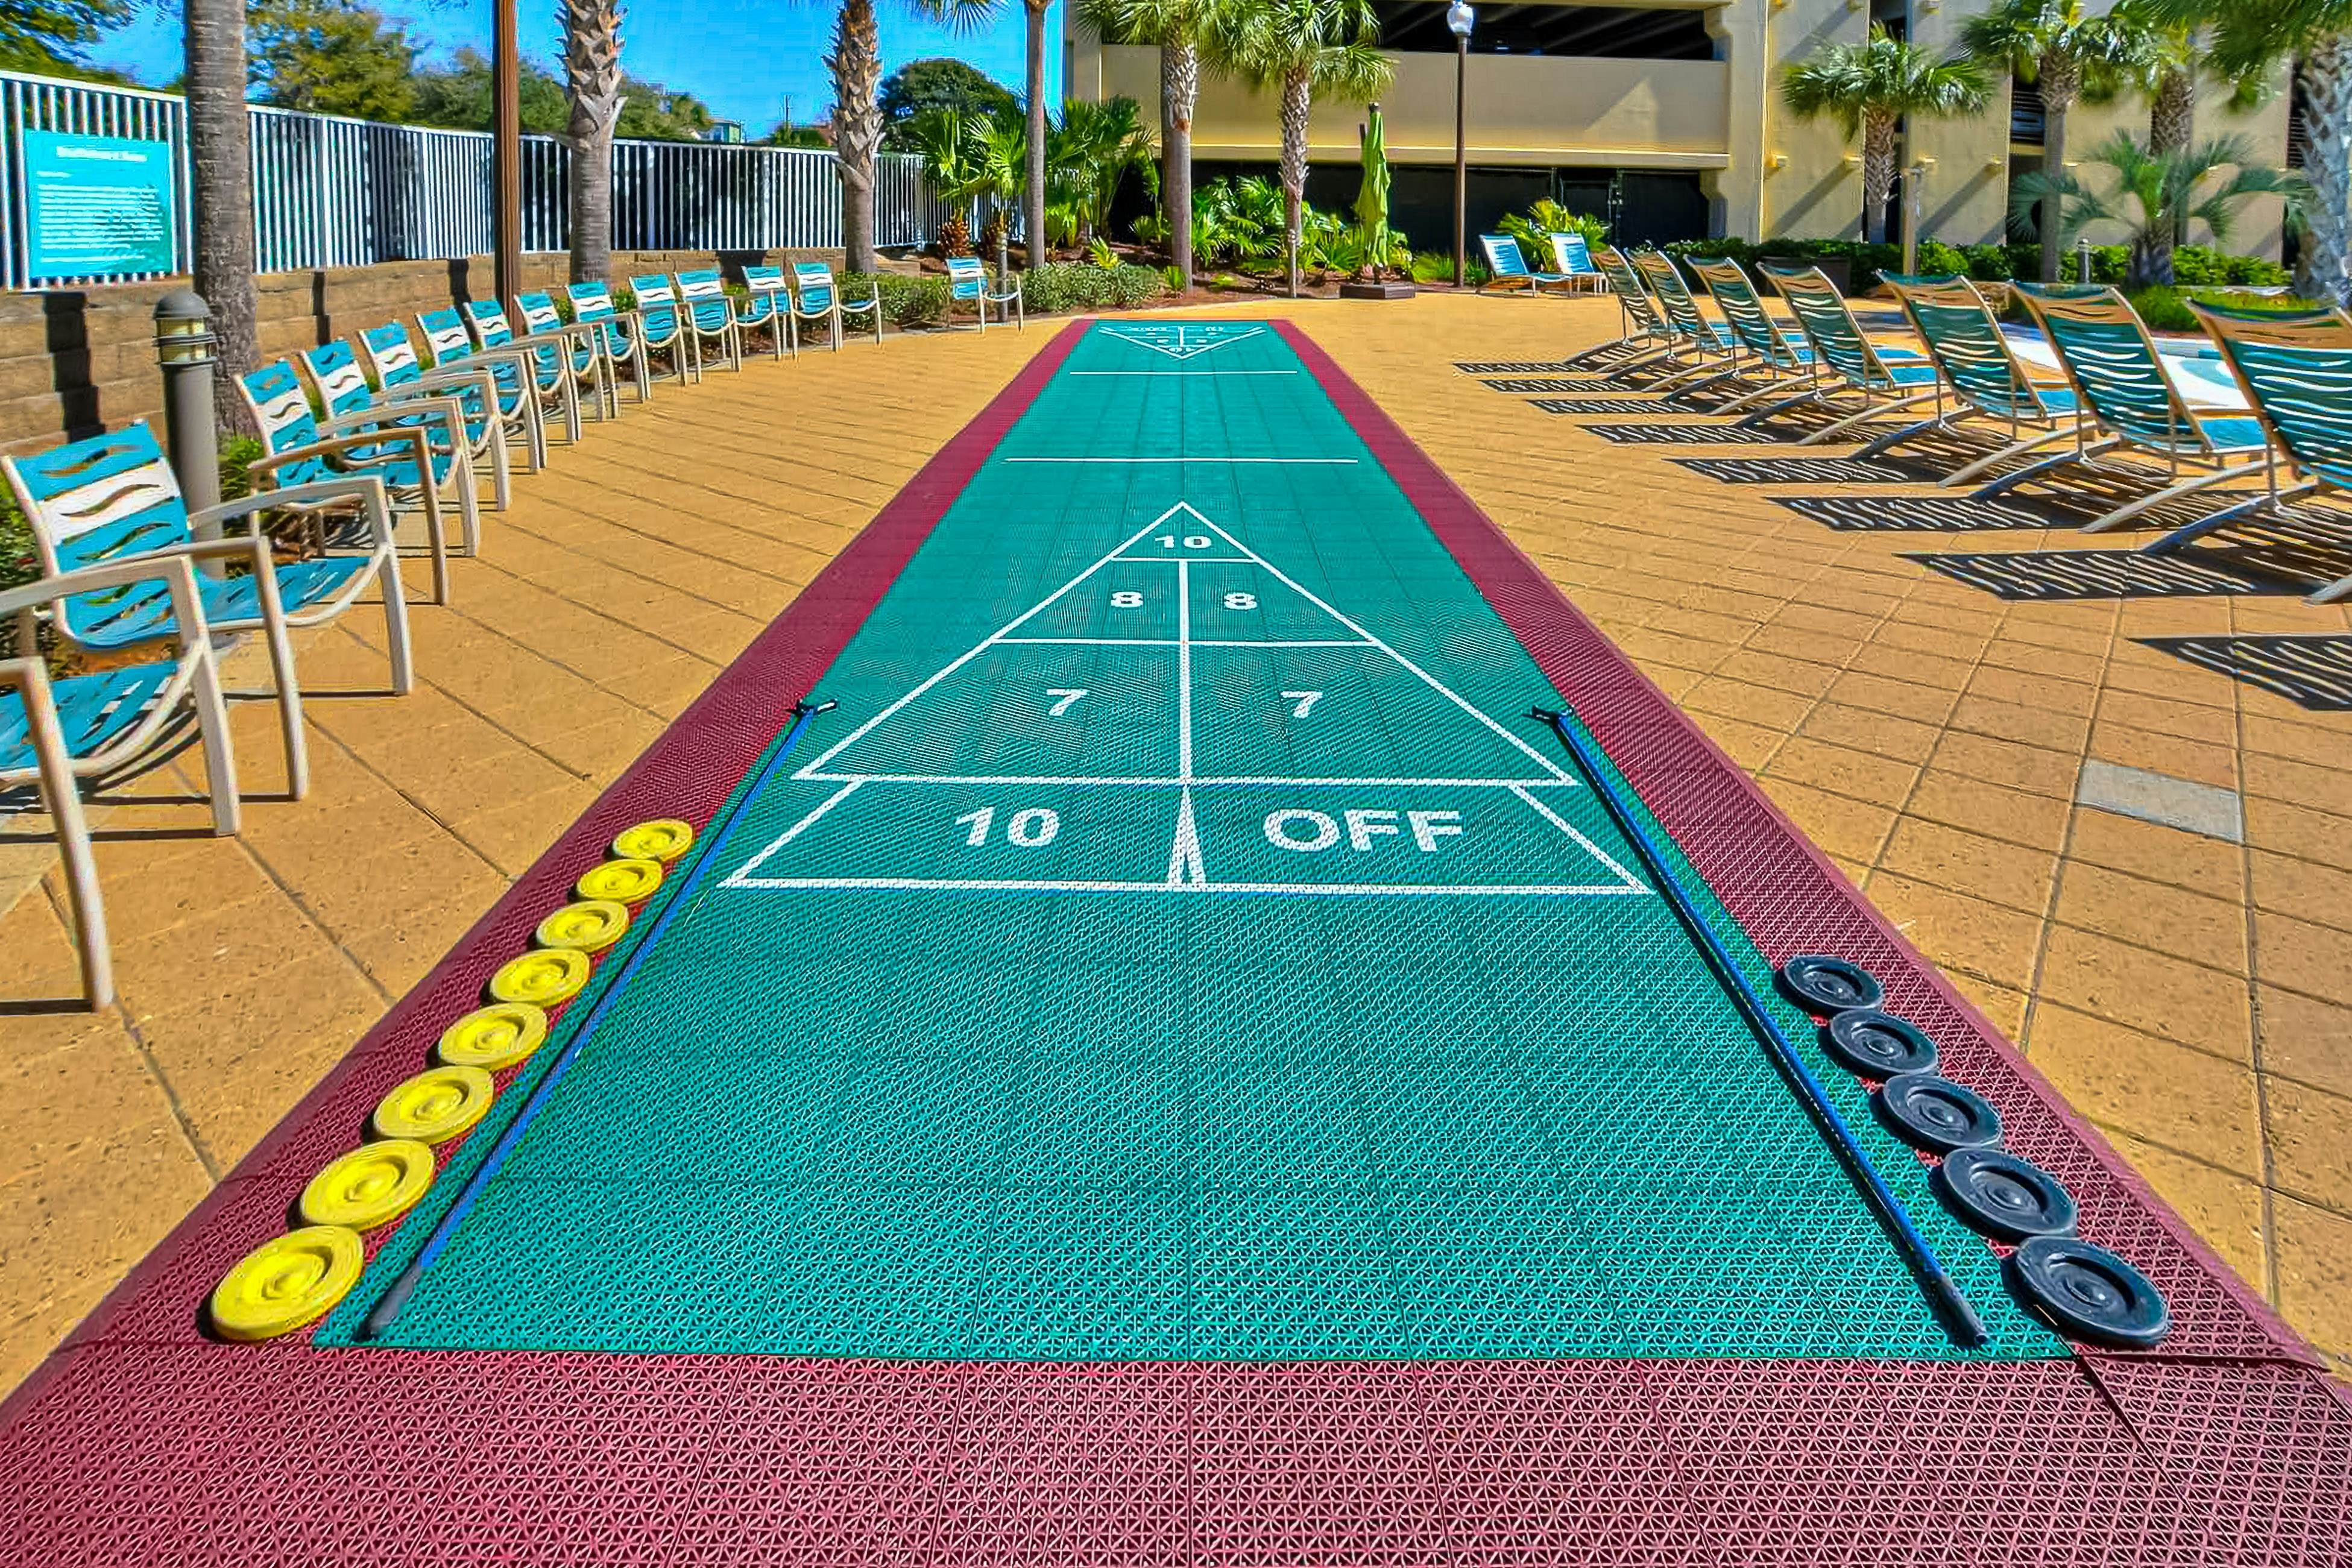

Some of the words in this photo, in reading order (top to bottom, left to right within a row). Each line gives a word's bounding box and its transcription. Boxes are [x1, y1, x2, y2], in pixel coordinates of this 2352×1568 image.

[1154, 534, 1211, 549] 10
[1110, 590, 1144, 609] 8
[1223, 591, 1258, 611] 8
[1045, 688, 1089, 717] 7
[1280, 690, 1323, 719] 7
[955, 806, 1061, 848] 10
[1263, 808, 1463, 852] OFF
